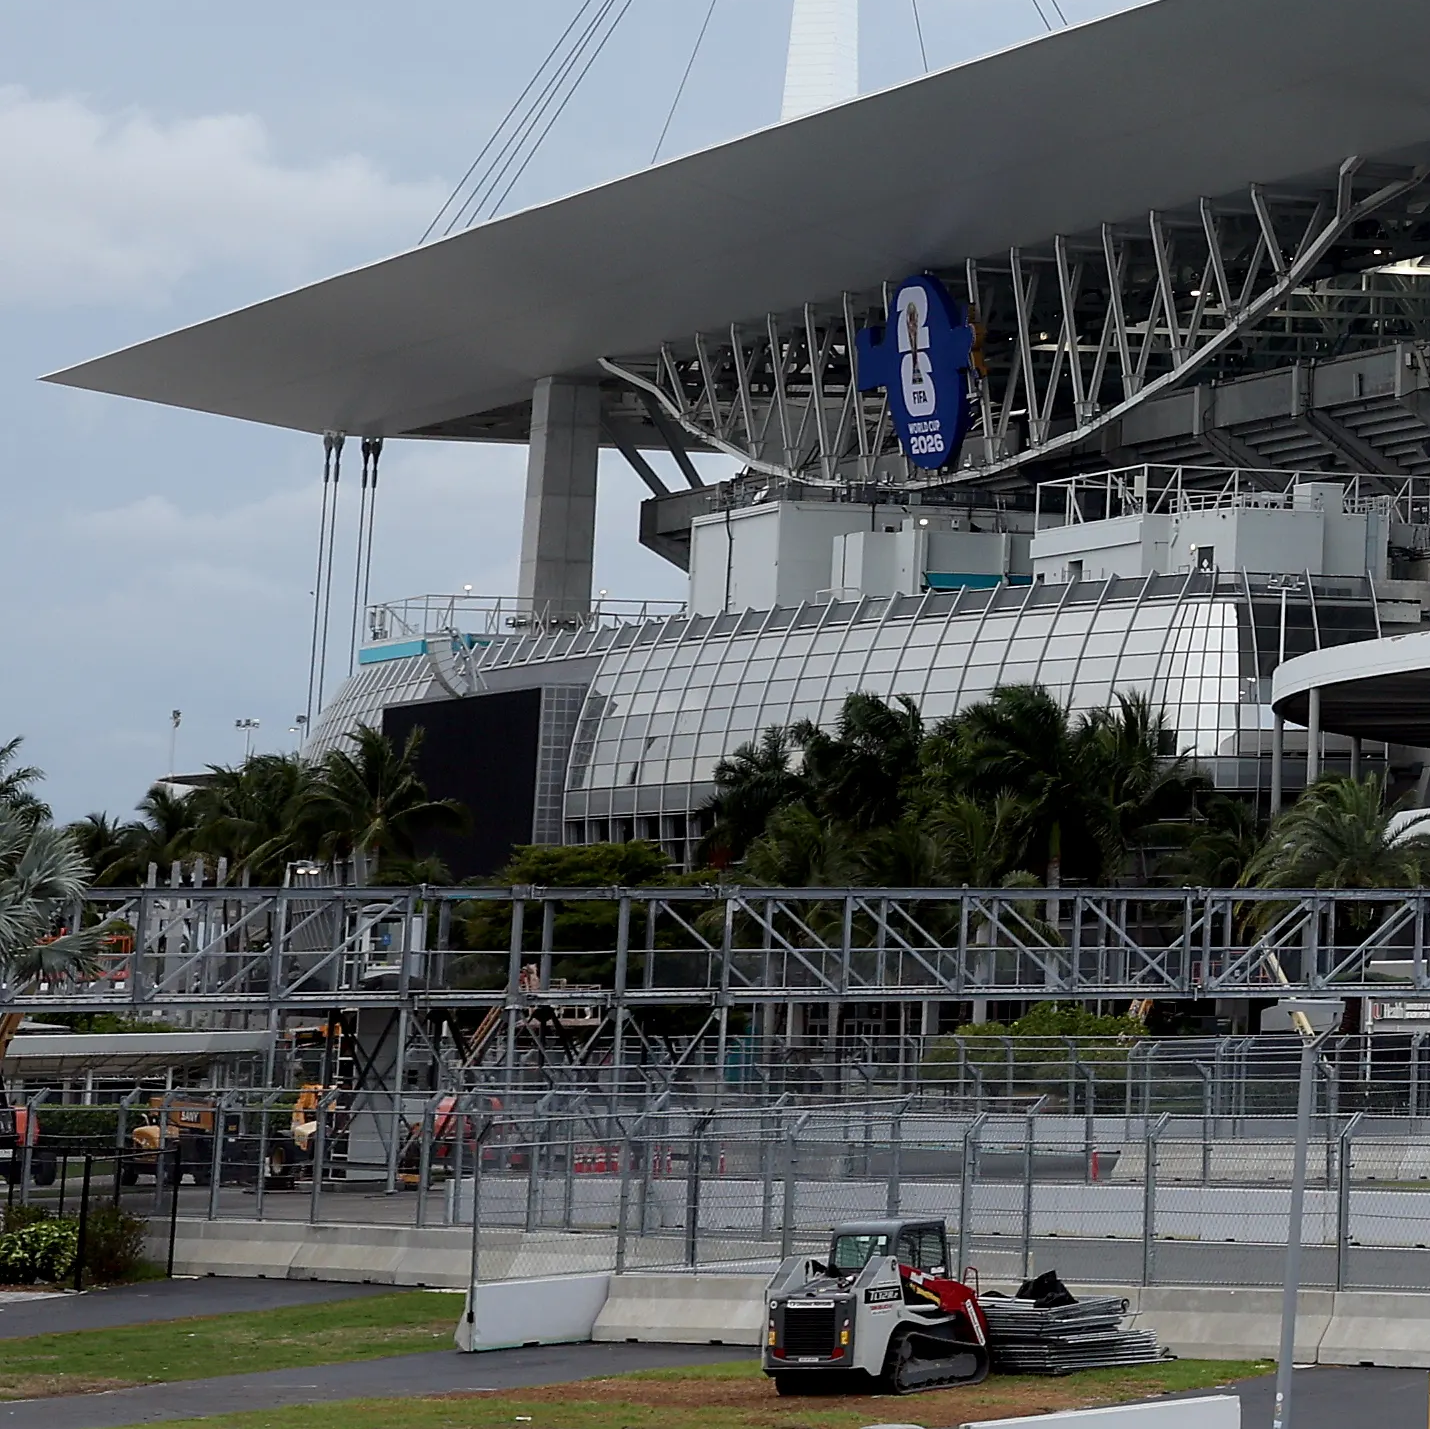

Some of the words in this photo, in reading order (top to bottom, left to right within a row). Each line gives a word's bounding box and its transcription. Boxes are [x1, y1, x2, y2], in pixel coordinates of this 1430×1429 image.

[912, 390, 928, 405] FIFA
[908, 421, 929, 435] WORLD
[929, 419, 940, 433] CUP
[910, 433, 945, 456] 2026
